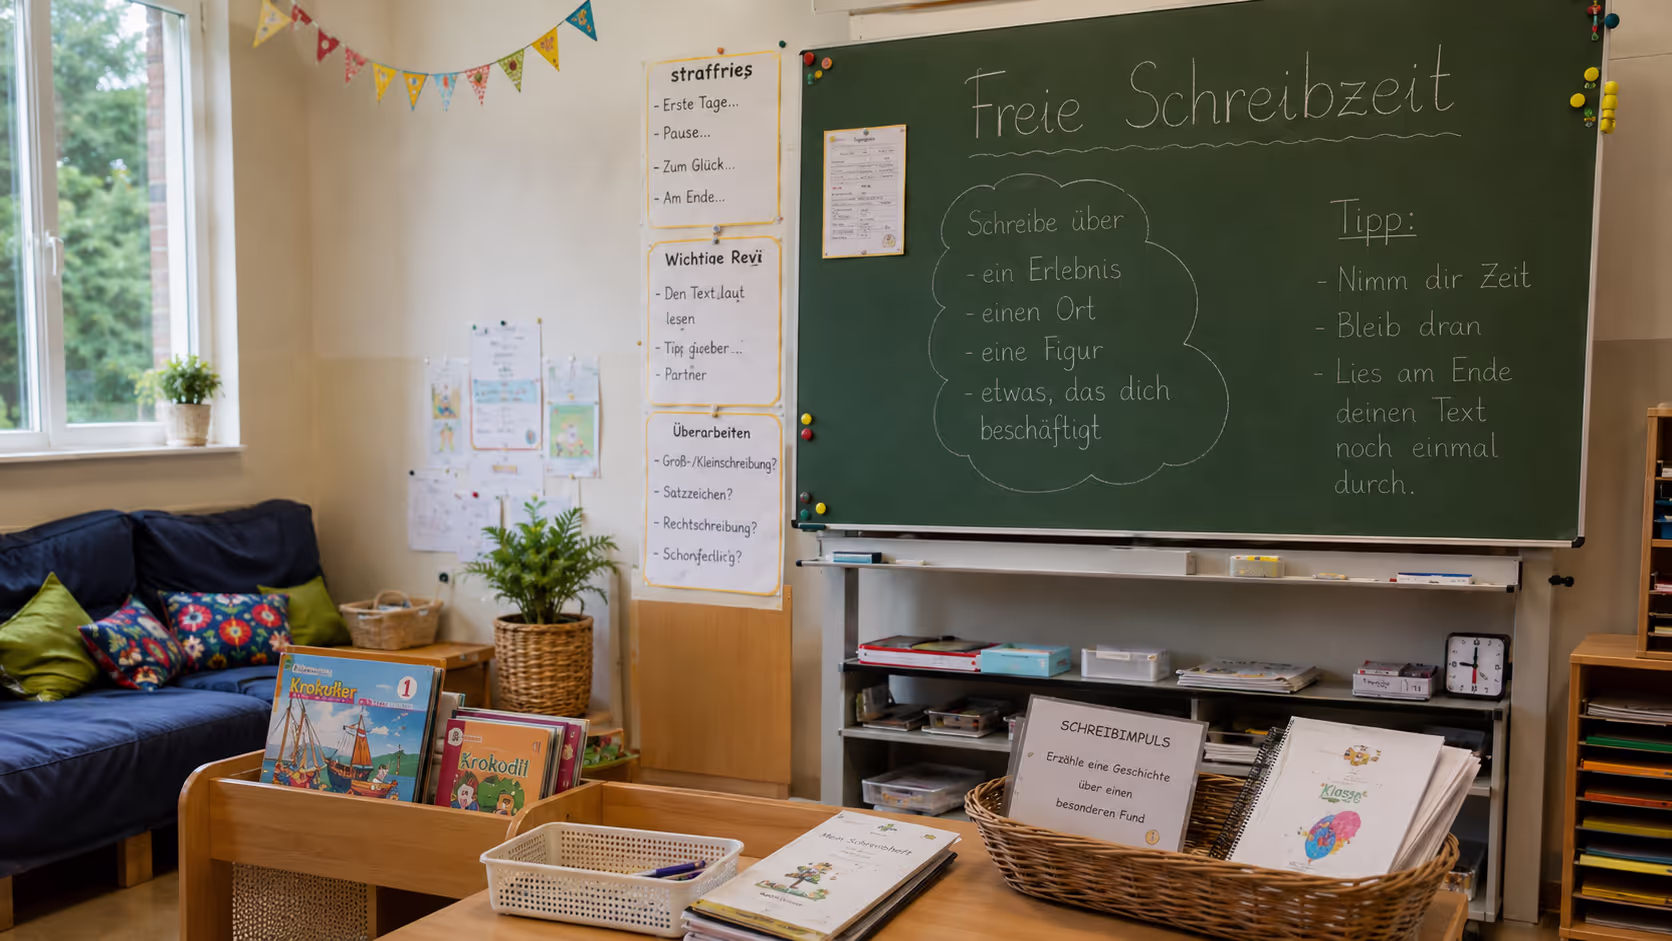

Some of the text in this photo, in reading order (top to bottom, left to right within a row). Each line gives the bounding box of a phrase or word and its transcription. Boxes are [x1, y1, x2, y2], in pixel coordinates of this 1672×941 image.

[964, 43, 1455, 139] Freie Schreibzeit
[663, 98, 694, 111] Erste
[699, 96, 738, 113] Tage...
[663, 126, 711, 139] Pause...
[663, 160, 687, 173] Zum
[691, 157, 735, 172] Glück...
[663, 191, 681, 204] Am
[686, 189, 725, 204] Ende...
[968, 205, 1125, 236] Schreibe über
[1330, 198, 1414, 246] Tipp:
[982, 263, 1014, 283] ein
[1030, 256, 1122, 282] Erlebnis
[1338, 265, 1408, 292] Nimm
[1426, 263, 1463, 289] dir
[1480, 261, 1531, 289] Zeit
[665, 286, 686, 300] Den
[690, 286, 716, 299] Text
[666, 312, 695, 325] lesen
[982, 303, 1041, 323] einen
[1056, 296, 1096, 321] Ort
[1338, 311, 1400, 338] Bleib
[1419, 310, 1481, 337] dran
[982, 342, 1027, 362] eine
[1044, 336, 1103, 371] Figur
[665, 367, 707, 381] Partner
[1337, 358, 1382, 384] Lies
[1398, 366, 1434, 382] am
[1453, 356, 1513, 382] Ende
[982, 377, 1053, 406] etwas,
[1065, 376, 1106, 401] das
[1120, 374, 1170, 401] dich
[1336, 396, 1486, 423] deinen Text
[673, 422, 750, 439] Überarbeiten
[981, 413, 1102, 450] beschäftigt
[1337, 432, 1499, 458] noch einmal
[662, 454, 777, 474] Groß-/Kleinschreibung?
[663, 486, 733, 500] Satzzeichen?
[1335, 469, 1414, 494] durch.
[663, 516, 757, 538] Rechtschreibung?
[402, 679, 411, 697] 1
[1060, 720, 1171, 748] SCHREIBIMPULS
[1046, 752, 1170, 783] Erzähle eine Geschichte
[1078, 780, 1133, 799] über einen
[1056, 798, 1146, 824] besonderen Fund
